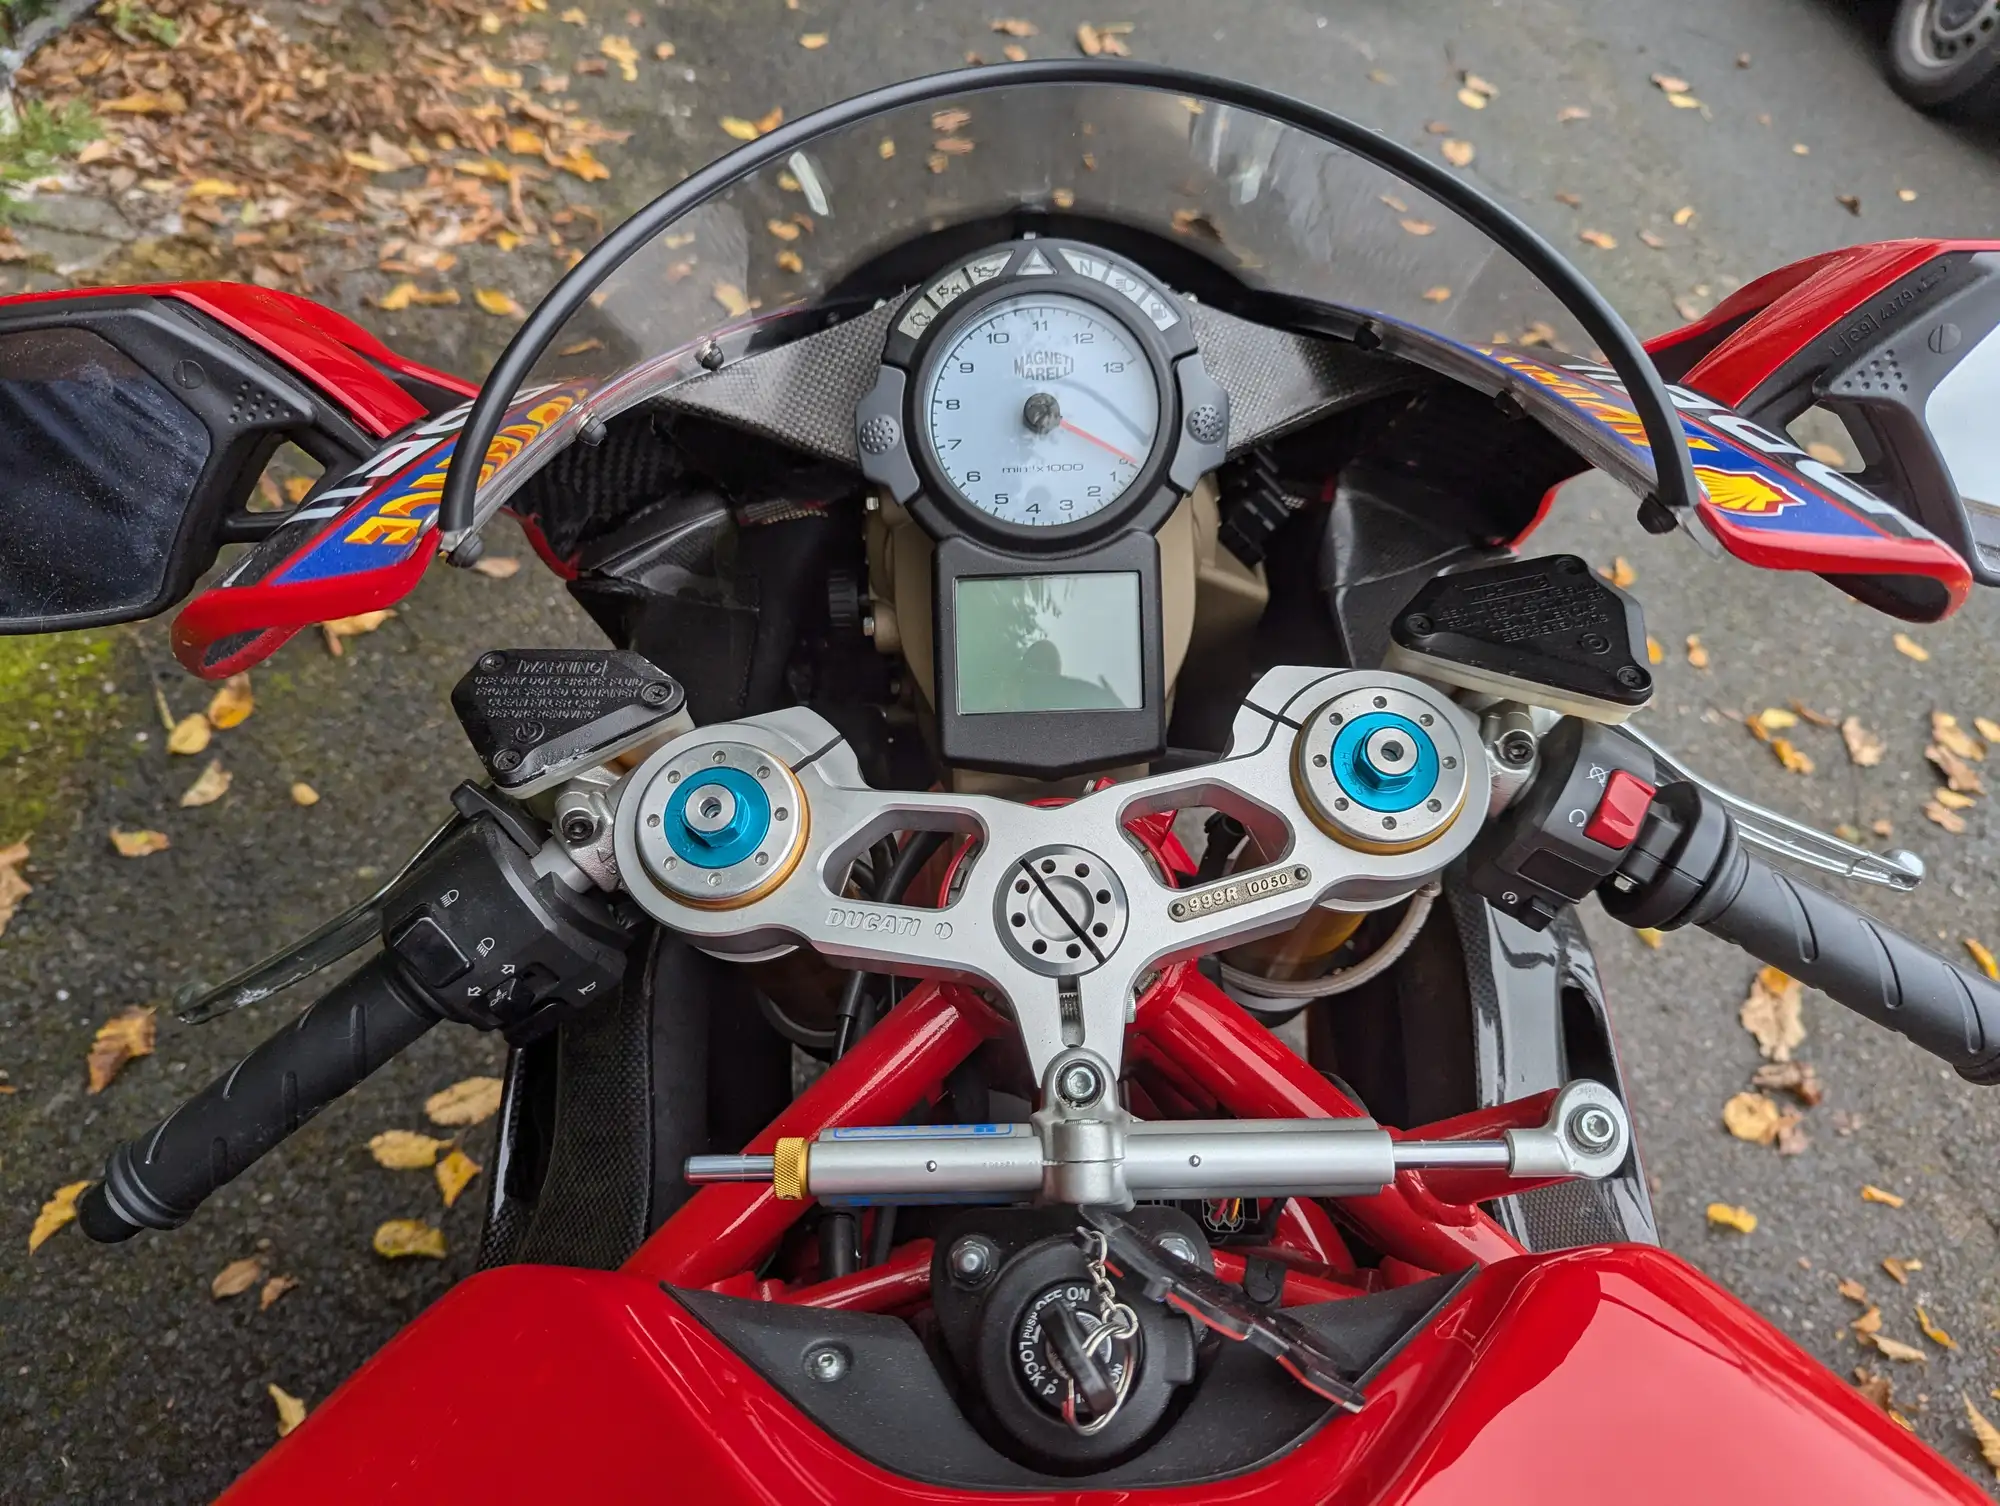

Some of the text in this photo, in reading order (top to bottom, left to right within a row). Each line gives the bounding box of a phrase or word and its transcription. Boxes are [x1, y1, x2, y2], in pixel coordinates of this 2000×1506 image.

[1079, 261, 1093, 276] N
[1032, 320, 1049, 332] 11
[986, 332, 1010, 345] 10
[1072, 332, 1095, 345] 12
[959, 362, 975, 375] 9
[1103, 362, 1125, 374] 13
[945, 399, 961, 412] 8
[947, 438, 963, 451] 7
[966, 471, 981, 483] 6
[1110, 471, 1117, 482] 1
[1086, 485, 1101, 498] 2
[994, 493, 1009, 506] 5
[1059, 499, 1074, 511] 3
[1025, 503, 1042, 515] 4
[520, 660, 602, 675] WARNING
[1188, 873, 1288, 912] 999R 0050
[825, 908, 921, 936] DUCATI
[1066, 1287, 1091, 1302] ON
[1019, 1341, 1046, 1387] LOCK
[1042, 1384, 1057, 1396] P
